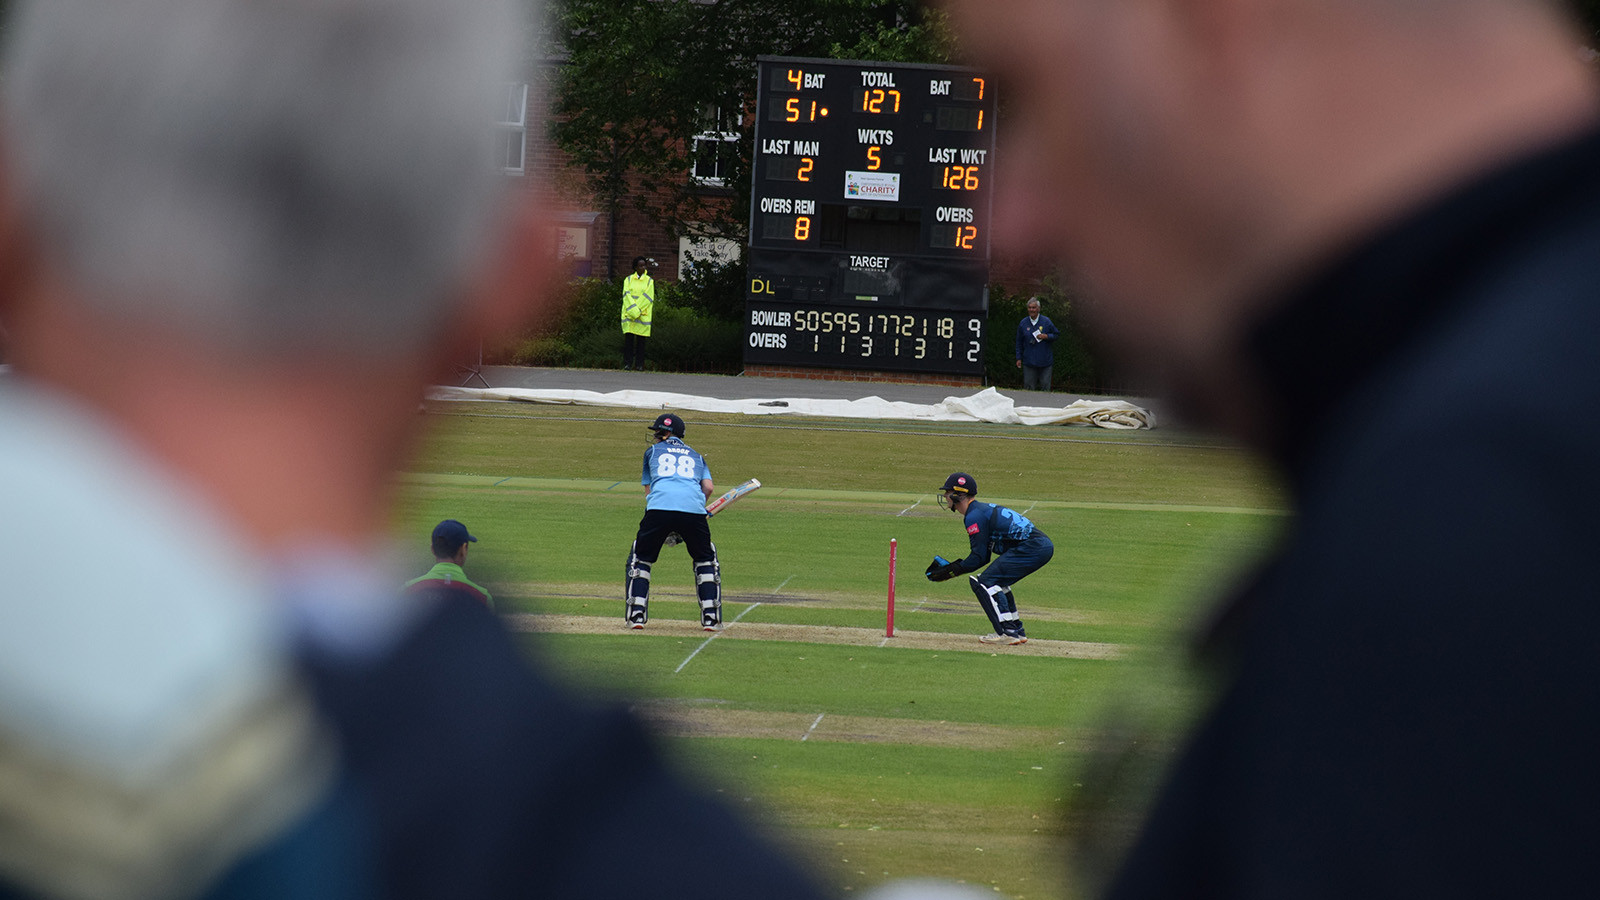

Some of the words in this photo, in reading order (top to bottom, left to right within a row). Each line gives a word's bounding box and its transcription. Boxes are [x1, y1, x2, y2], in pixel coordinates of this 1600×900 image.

[787, 69, 802, 91] 4
[804, 73, 825, 89] BAT
[861, 71, 896, 87] TOTAL
[930, 79, 951, 96] BAT
[973, 77, 985, 100] 7
[863, 89, 901, 113] 127
[977, 109, 984, 130] 1
[858, 129, 893, 145] WKTS
[762, 139, 790, 155] LAST
[793, 140, 819, 157] MAN
[929, 148, 956, 164] LAST
[960, 149, 987, 165] WKT
[867, 146, 881, 170] 5
[797, 158, 814, 182] 2
[943, 166, 979, 191] 126
[860, 185, 896, 195] CHARITY
[761, 197, 792, 214] OVERS
[794, 199, 815, 215] REM
[936, 206, 973, 223] OVERS
[794, 216, 811, 241] 8
[955, 226, 977, 249] 12
[850, 255, 890, 269] TARGET
[751, 279, 775, 295] DL
[751, 310, 791, 327] BOWLER
[750, 332, 787, 349] OVERS
[657, 453, 695, 479] 88
